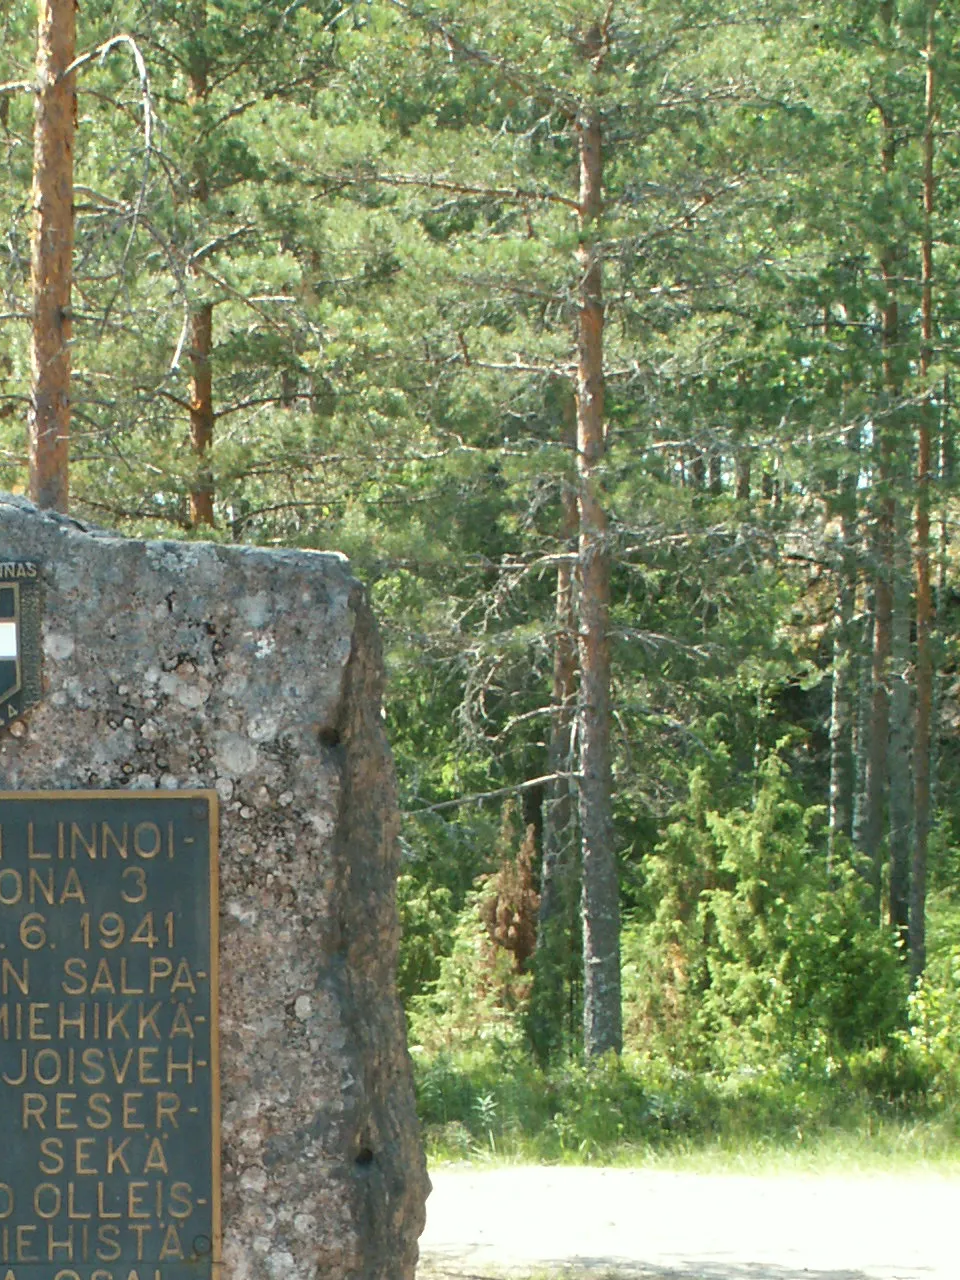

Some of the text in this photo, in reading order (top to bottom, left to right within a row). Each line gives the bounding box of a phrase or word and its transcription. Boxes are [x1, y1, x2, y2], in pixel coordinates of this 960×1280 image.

[28, 821, 194, 860] LINNOI-
[121, 867, 148, 903] 3
[80, 914, 177, 950] 1941
[62, 957, 207, 997] SALPA-
[23, 1093, 198, 1130] RESER-
[39, 1133, 168, 1175] SEKÄ
[34, 1181, 207, 1219] OLLEIS-
